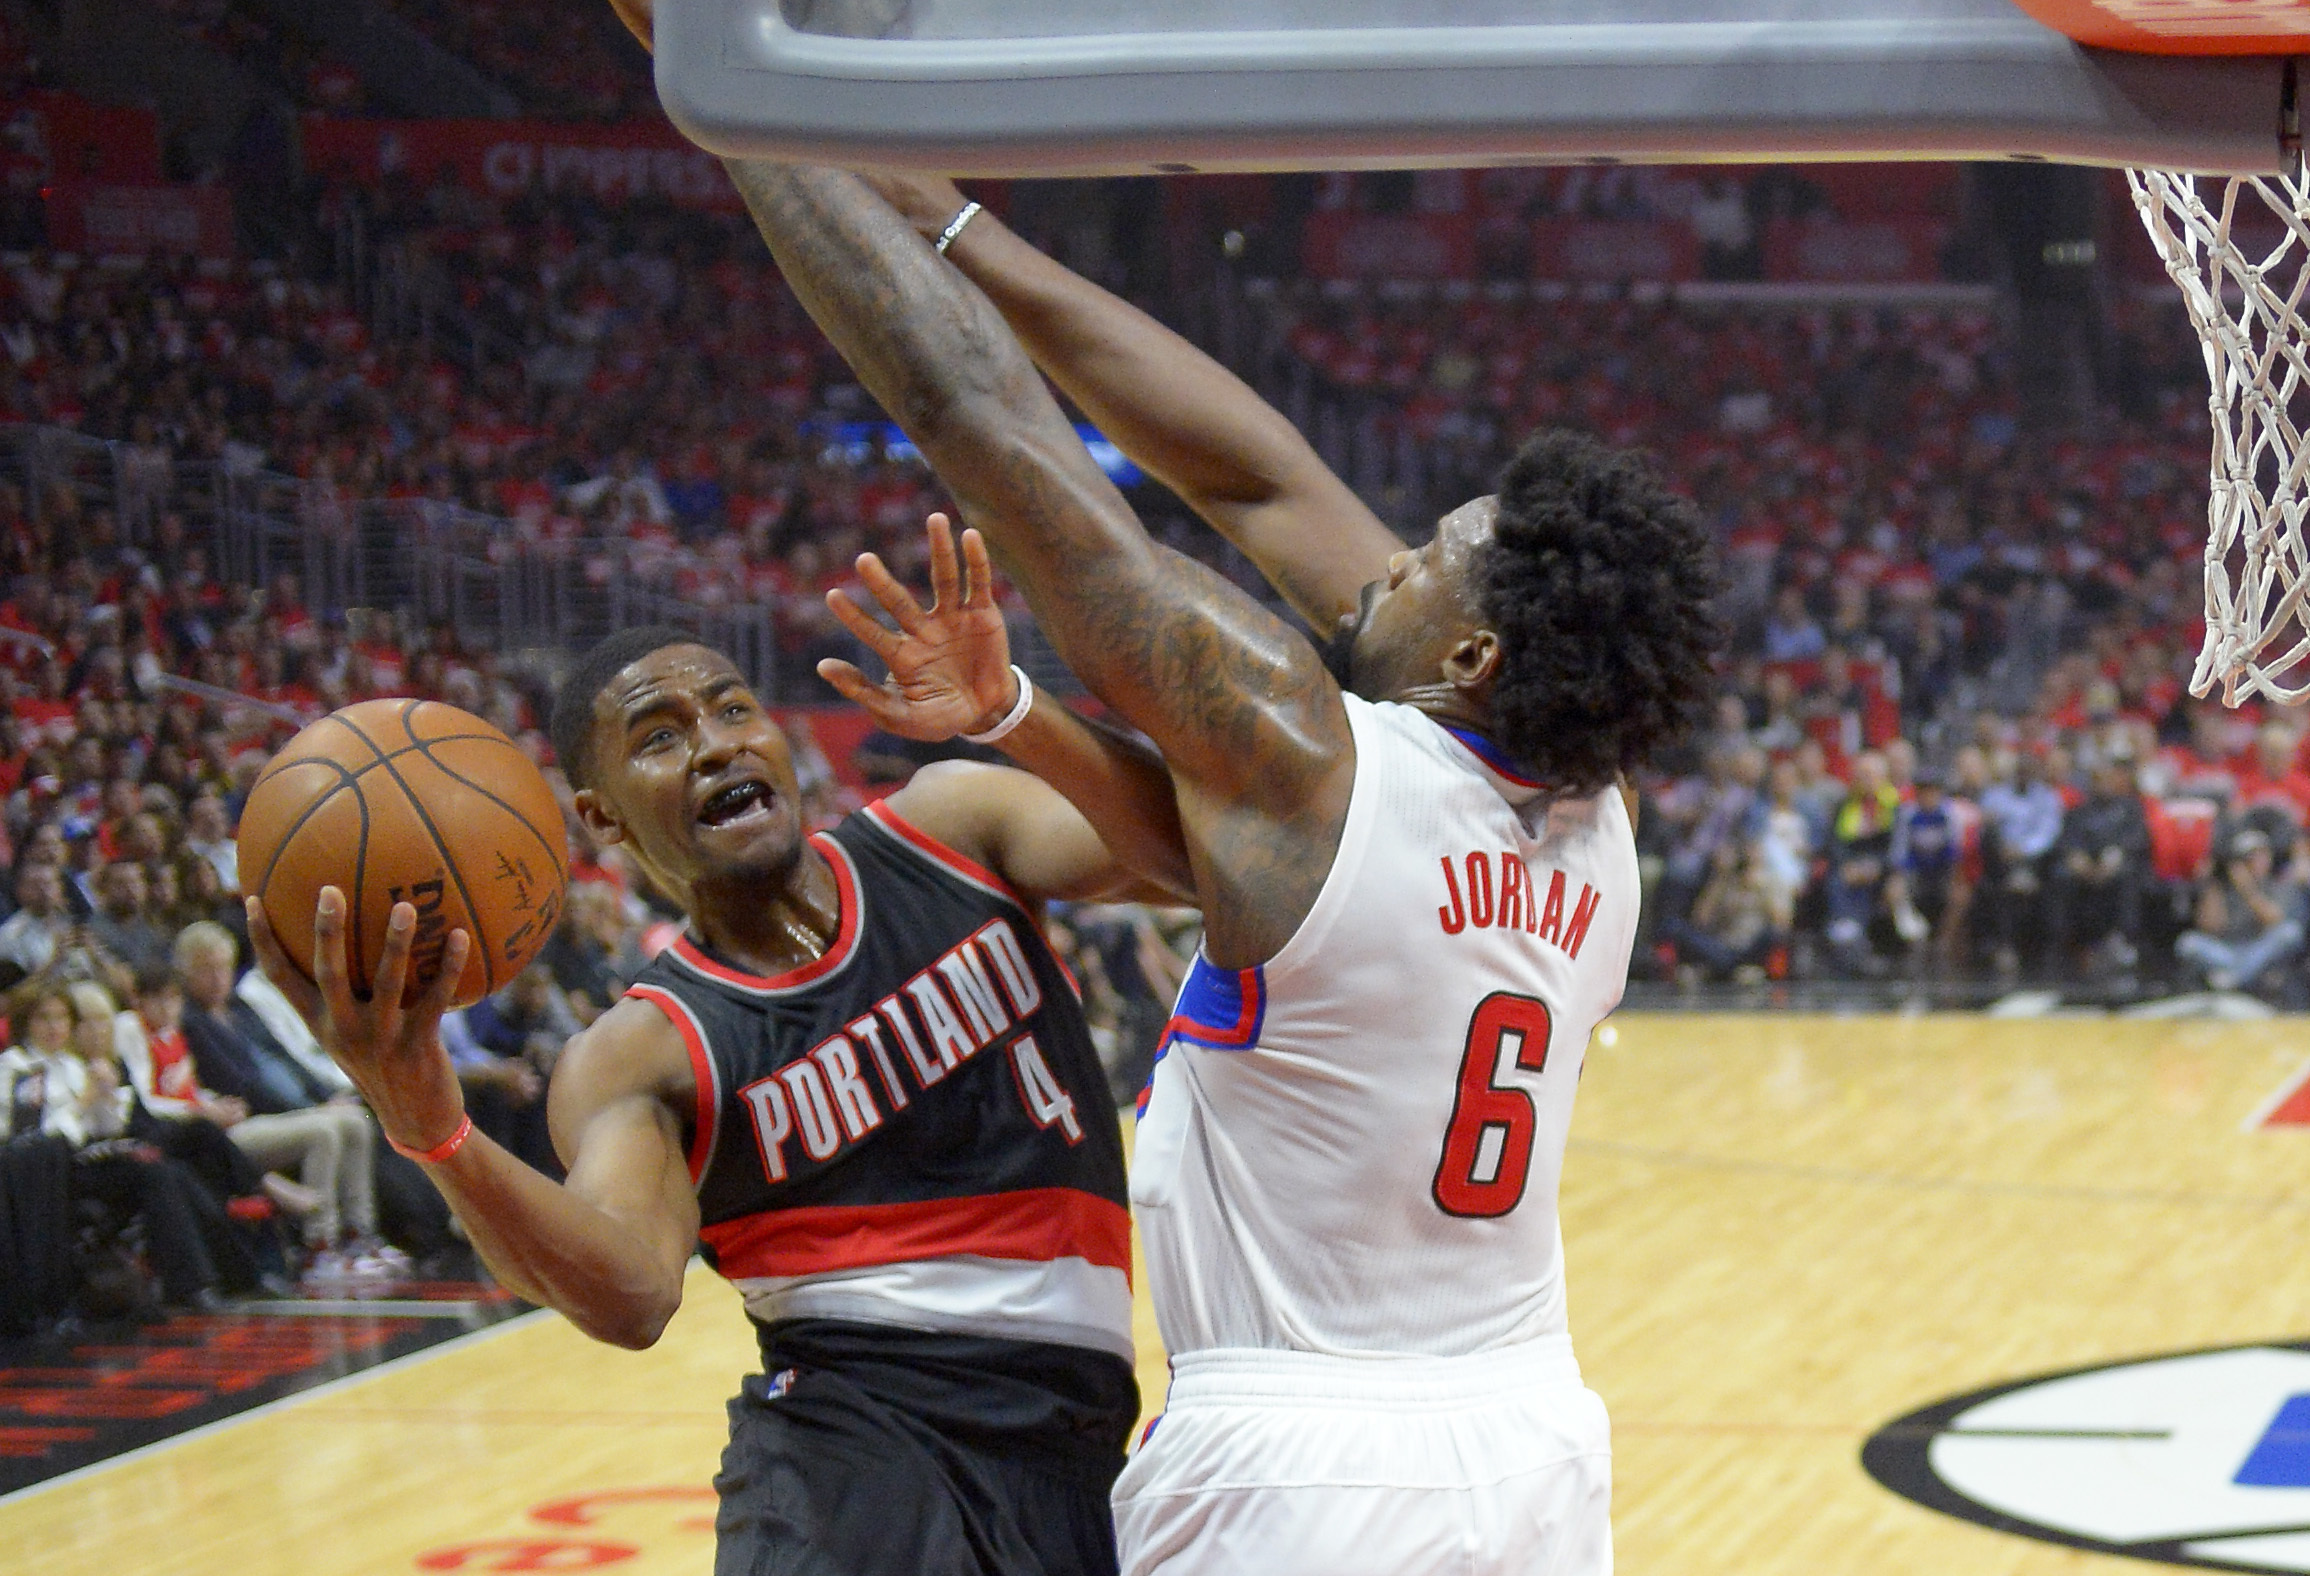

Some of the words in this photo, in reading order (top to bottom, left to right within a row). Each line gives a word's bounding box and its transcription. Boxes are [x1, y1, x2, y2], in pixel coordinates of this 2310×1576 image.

[1439, 851, 1602, 959] JORDAN
[737, 917, 1042, 1184] PORTLAND
[1006, 1031, 1086, 1146] 4
[1432, 990, 1552, 1219] 6
